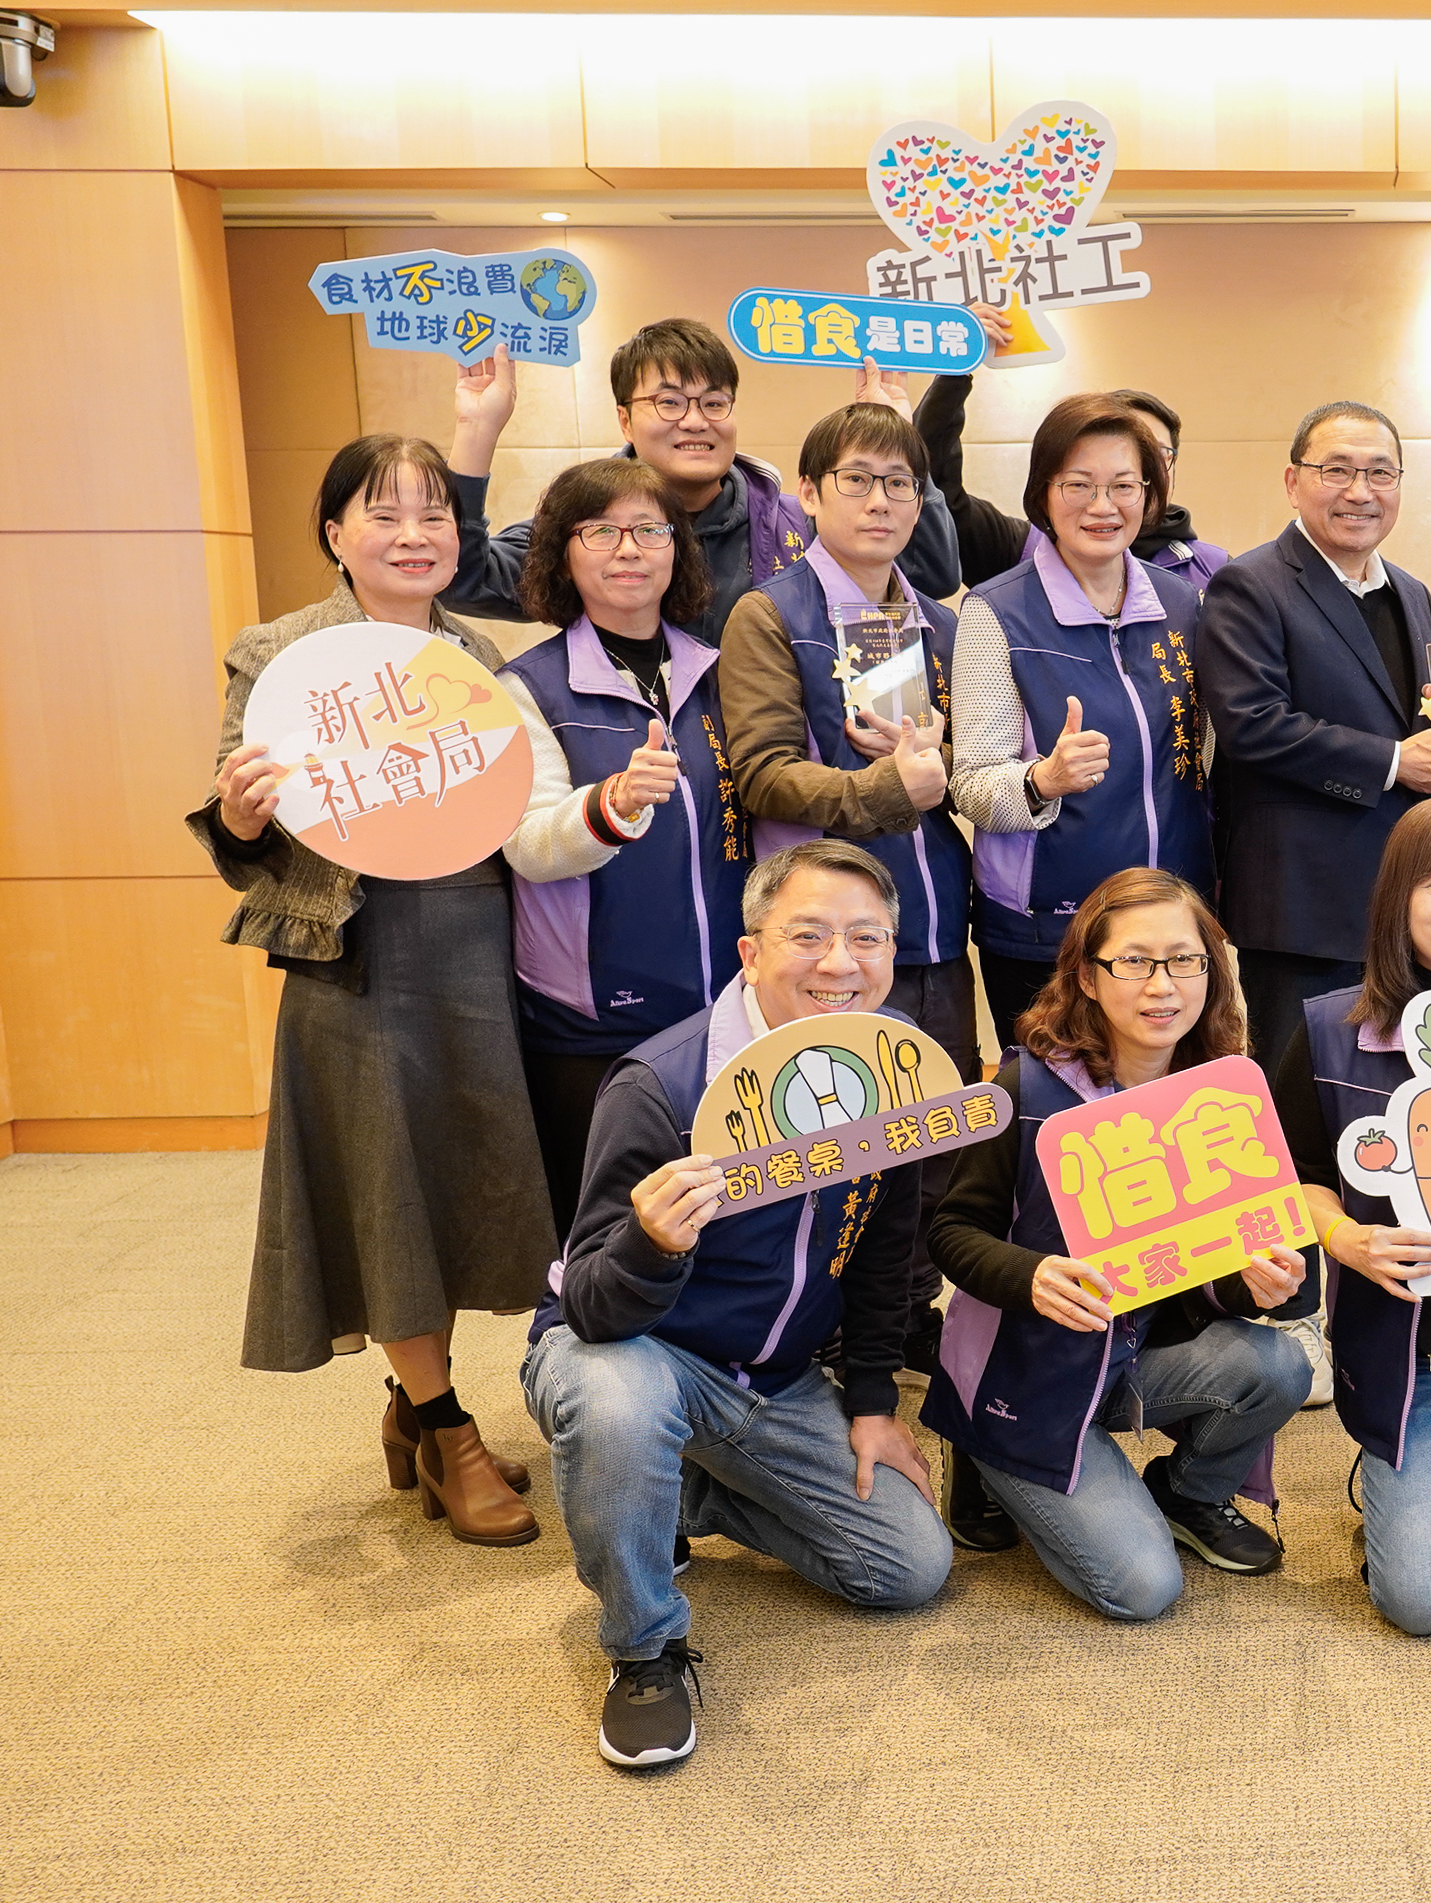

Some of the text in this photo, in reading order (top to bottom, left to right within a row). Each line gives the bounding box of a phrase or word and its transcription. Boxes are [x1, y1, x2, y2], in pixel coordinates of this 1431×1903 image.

[321, 260, 517, 306] 食材不浪費
[875, 232, 1141, 307] 新北社工
[376, 309, 569, 356] 地球少流淚
[751, 296, 969, 359] 惜食是日常
[1152, 641, 1177, 684] 局長
[304, 661, 428, 751] 新北
[1169, 696, 1191, 780] 李美珍
[304, 719, 487, 842] 社會局
[716, 1094, 998, 1208] 的餐桌，我負責
[1058, 1086, 1281, 1240] 惜食
